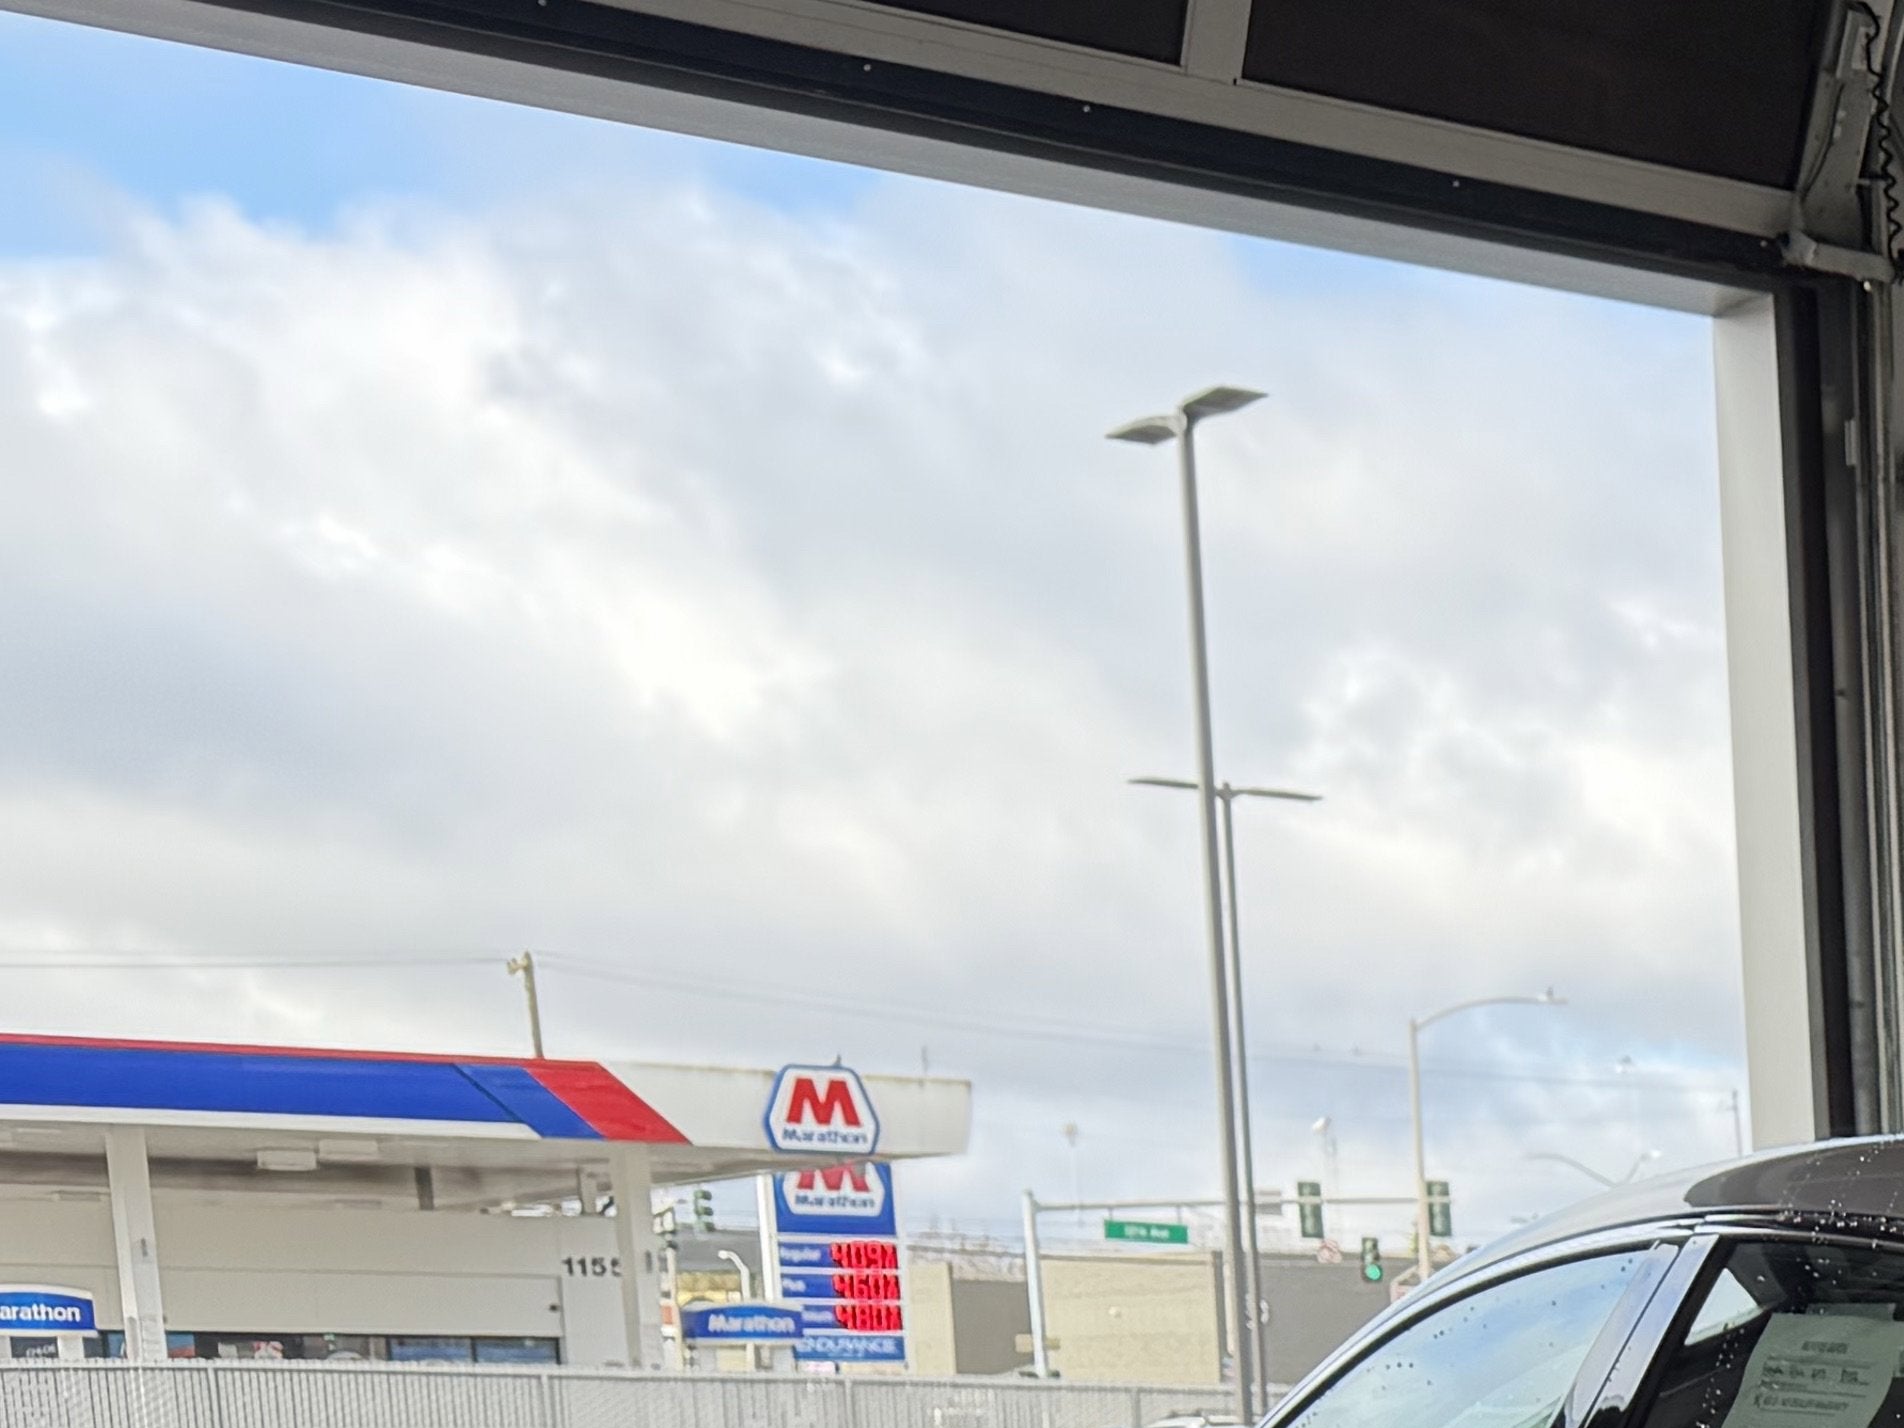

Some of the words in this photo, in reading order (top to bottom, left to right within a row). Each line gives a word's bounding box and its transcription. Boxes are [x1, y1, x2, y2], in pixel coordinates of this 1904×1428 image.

[786, 1077, 861, 1127] M
[0, 1303, 81, 1322] arathon
[708, 1314, 796, 1333] Marathon
